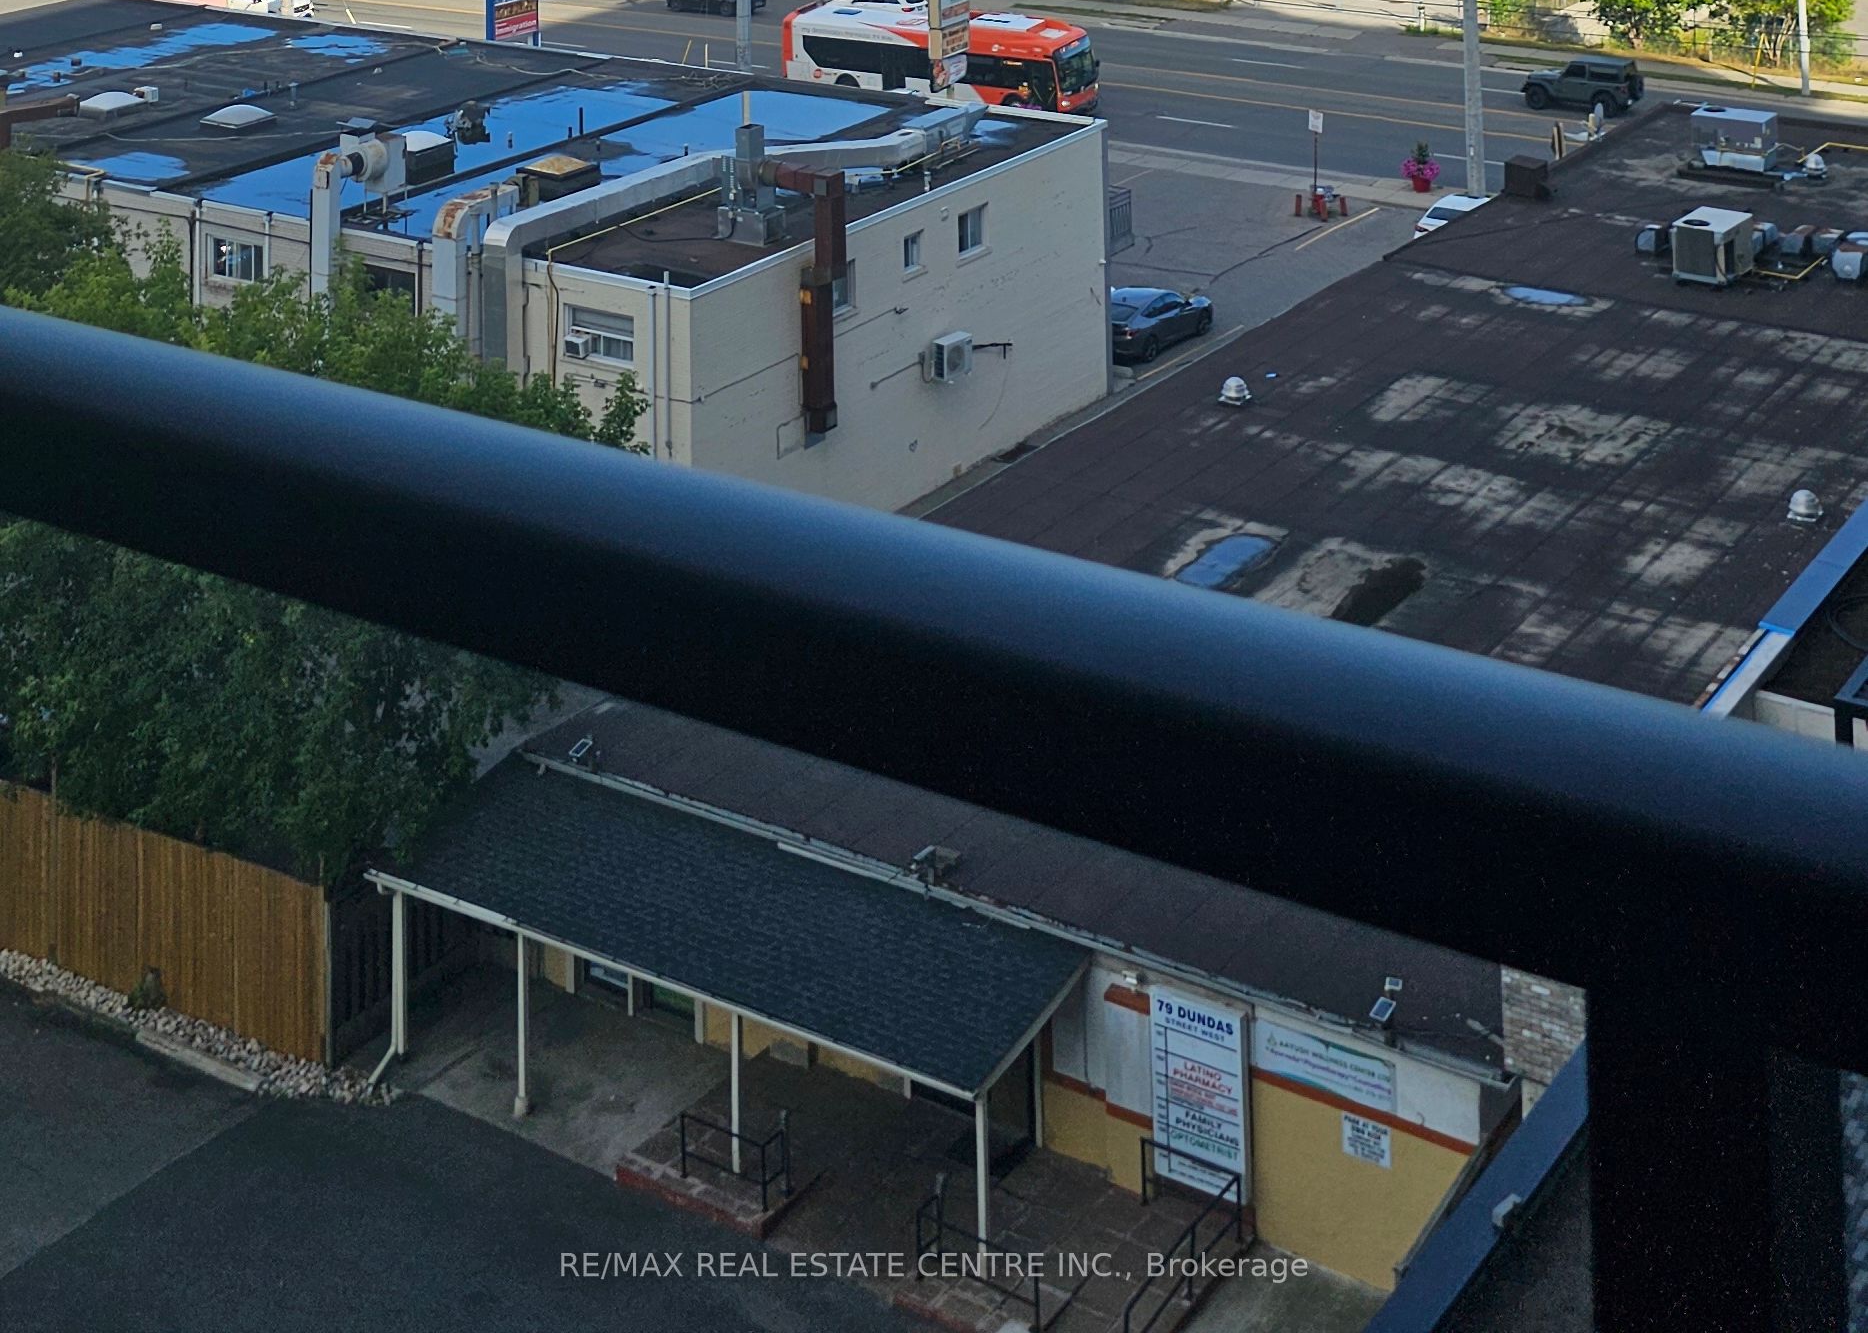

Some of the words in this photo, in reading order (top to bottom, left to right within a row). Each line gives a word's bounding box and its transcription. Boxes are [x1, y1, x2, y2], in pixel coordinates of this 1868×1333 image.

[1157, 999, 1172, 1014] 79
[1178, 1005, 1233, 1035] DUNDAS
[1165, 1017, 1198, 1033] STREET
[1201, 1030, 1225, 1042] WEST
[1173, 1068, 1232, 1095] PHARMACY
[1184, 1061, 1222, 1081] LATINO
[1175, 1117, 1239, 1146] PHYSICIANS
[1185, 1110, 1222, 1129] FAMILY
[1171, 1129, 1238, 1160] OPTOMETRIST
